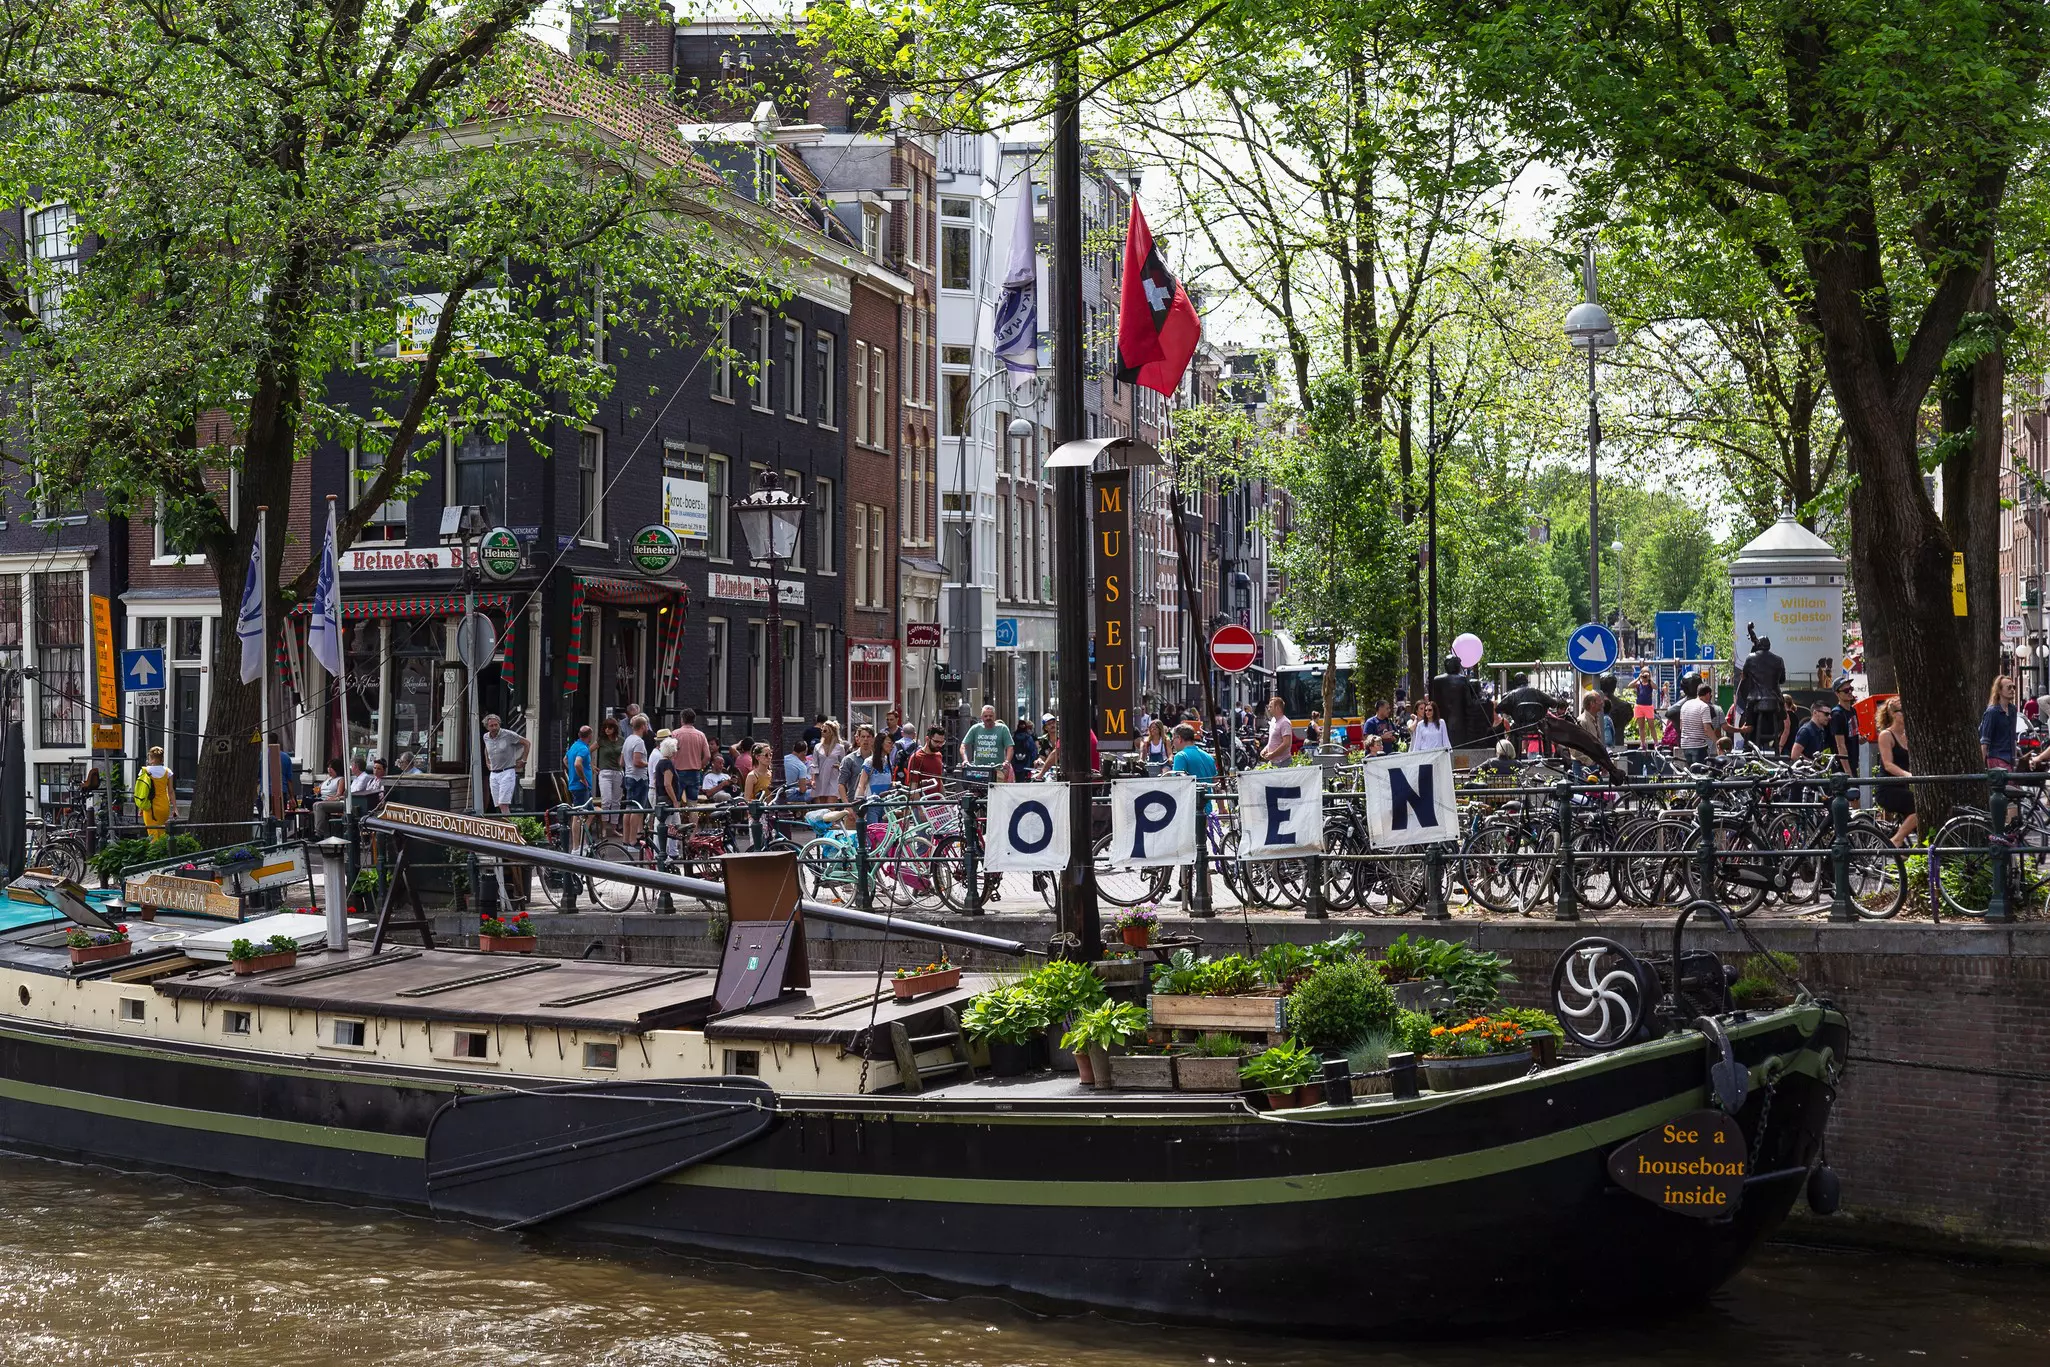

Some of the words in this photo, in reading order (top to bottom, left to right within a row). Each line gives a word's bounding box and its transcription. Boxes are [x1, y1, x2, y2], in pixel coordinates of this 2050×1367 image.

[484, 548, 519, 558] Heineken
[633, 545, 675, 555] Heineken
[353, 551, 439, 570] Heineken
[714, 573, 752, 599] Heineken
[1099, 486, 1128, 735] MUSEUM
[1780, 596, 1827, 609] William
[1773, 611, 1832, 624] Eggleston
[908, 624, 940, 636] coffeeshop
[1704, 646, 1712, 657] P
[1663, 1124, 1699, 1144] See
[1713, 1130, 1726, 1144] a
[1637, 1155, 1745, 1176] houseboat
[1663, 1185, 1727, 1205] inside
